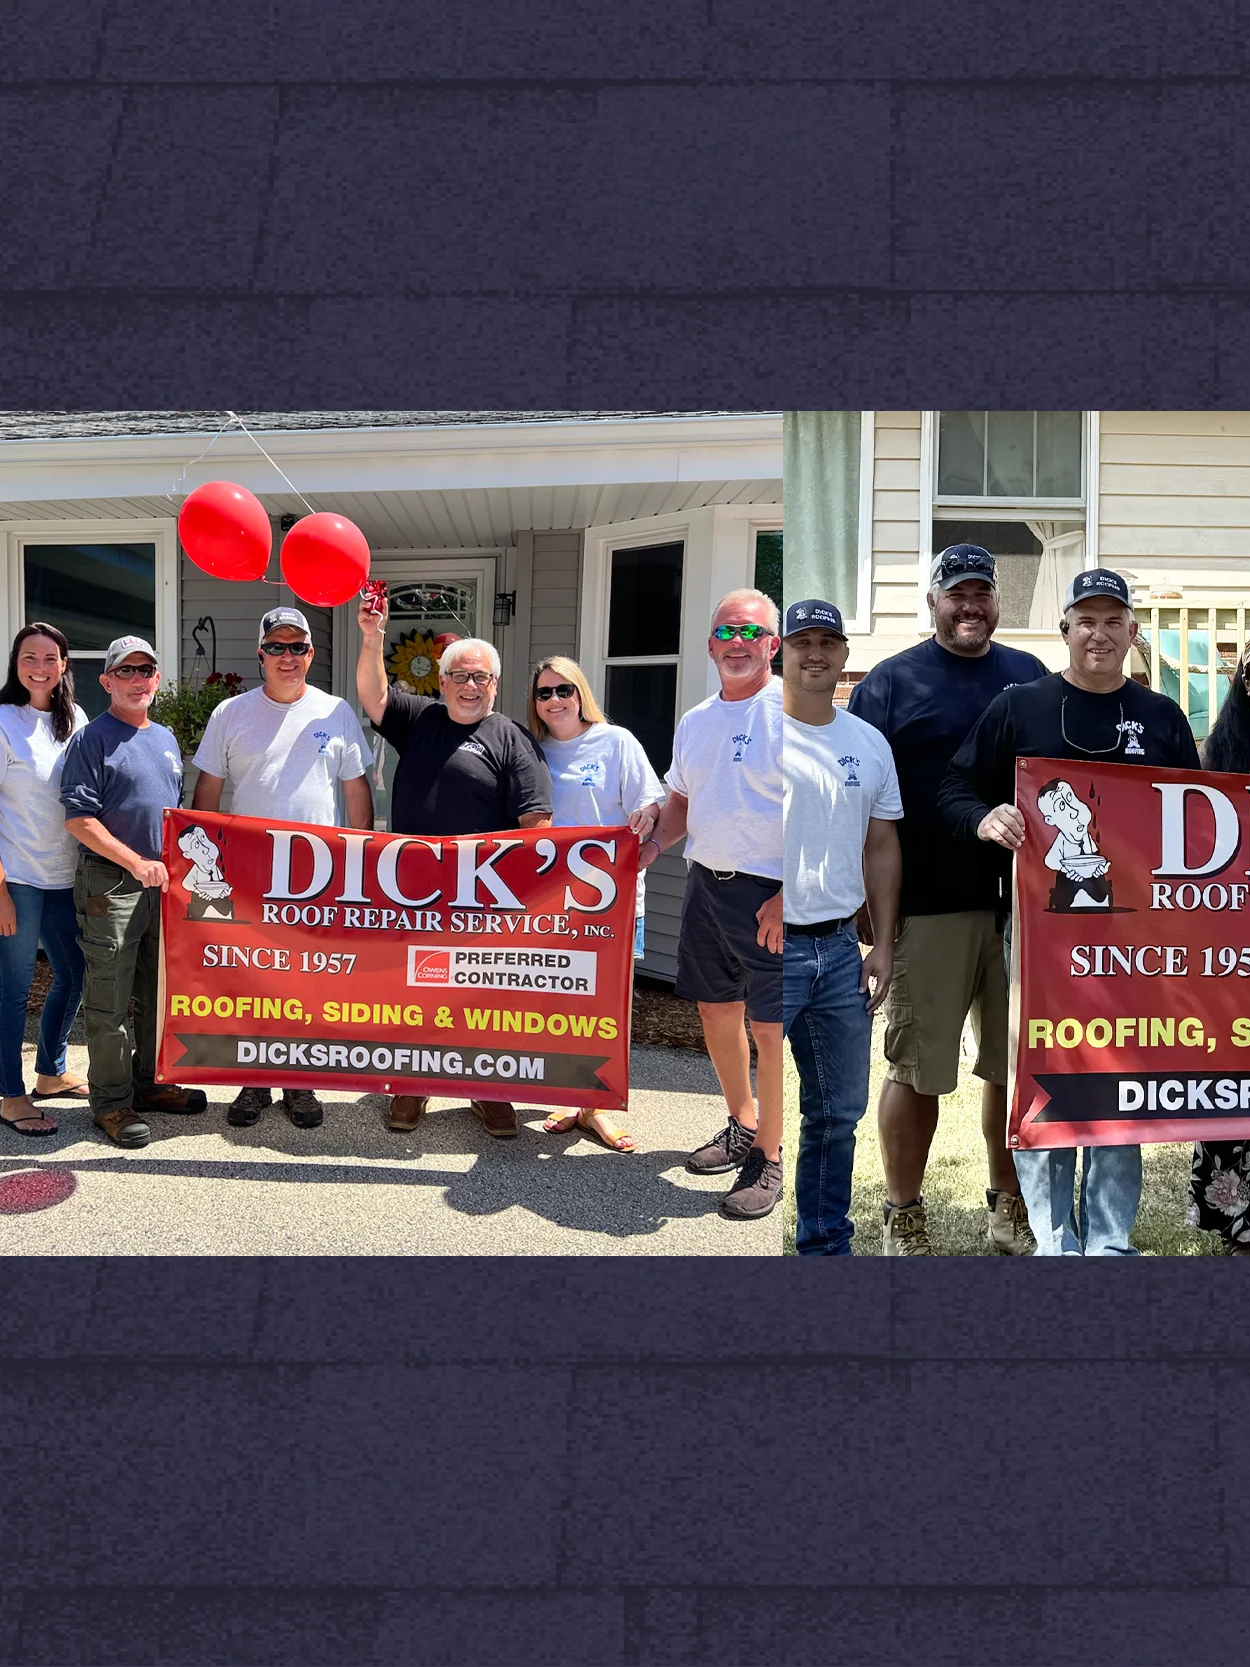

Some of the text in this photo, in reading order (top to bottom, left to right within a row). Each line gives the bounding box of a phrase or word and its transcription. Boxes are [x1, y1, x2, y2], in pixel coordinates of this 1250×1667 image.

[263, 828, 618, 913] DICK'S
[1149, 882, 1249, 912] ROOF
[262, 902, 616, 940] ROOF REPAIR SERVICE, INC.
[202, 944, 357, 975] SINCE 1957
[455, 951, 571, 968] PREFERRED
[1070, 945, 1189, 977] SINCE
[417, 972, 448, 980] CORNING
[454, 971, 589, 991] CONTRACTOR
[171, 994, 618, 1040] ROOFING, SIDING & WINDOWS
[1028, 1017, 1217, 1053] ROOFING,
[236, 1041, 545, 1080] DICKSROOFING.COM
